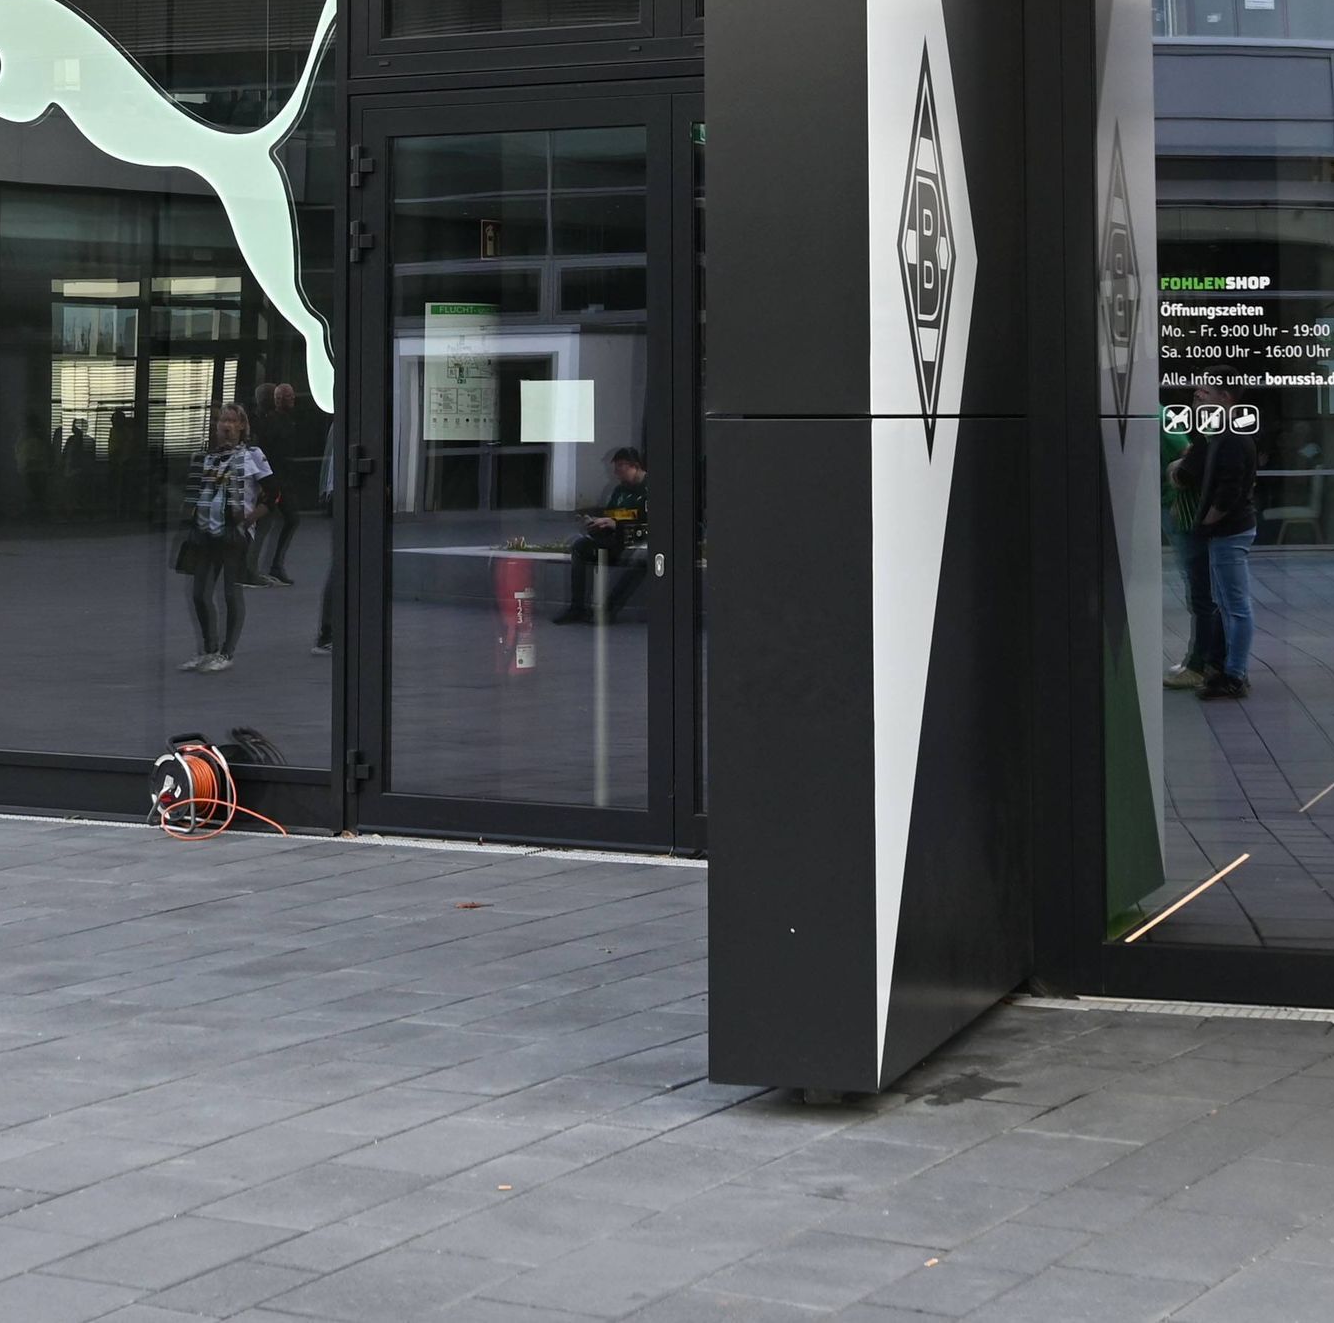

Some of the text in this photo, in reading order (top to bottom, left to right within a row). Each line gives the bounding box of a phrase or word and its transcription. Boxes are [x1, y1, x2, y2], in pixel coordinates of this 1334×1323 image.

[1160, 276, 1271, 290] FOHLENSHOP
[1160, 301, 1264, 319] Öffnungszeiten
[1161, 324, 1185, 337] Mo.
[1200, 324, 1217, 337] Fr.
[1220, 324, 1249, 337] 9:00
[1253, 323, 1278, 337] Uhr
[1293, 323, 1330, 337] 19:00
[1161, 345, 1181, 358] Sa.
[1185, 345, 1222, 358] 10:00
[1225, 344, 1250, 358] Uhr
[1265, 345, 1303, 358] 16:00
[1306, 344, 1331, 358] Uhr
[1161, 372, 1187, 385] Alle
[1190, 372, 1223, 385] Infos
[1227, 373, 1262, 385] unter
